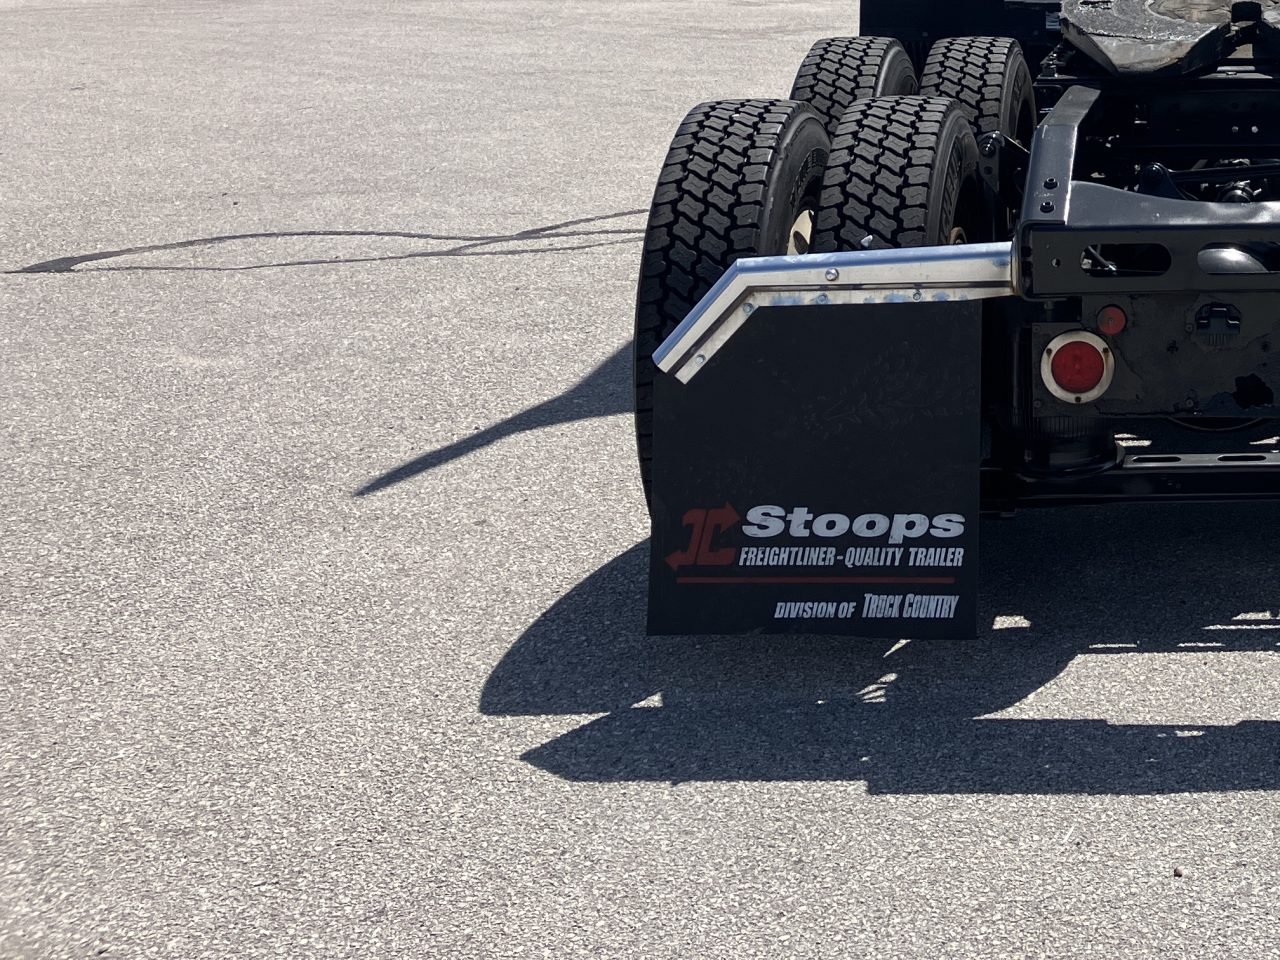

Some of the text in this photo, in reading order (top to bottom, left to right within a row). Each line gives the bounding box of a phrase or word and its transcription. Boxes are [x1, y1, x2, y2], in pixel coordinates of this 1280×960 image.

[741, 504, 966, 545] Stoops
[908, 547, 965, 567] TRAILER
[774, 601, 836, 619] DIVISION
[839, 601, 857, 618] OF
